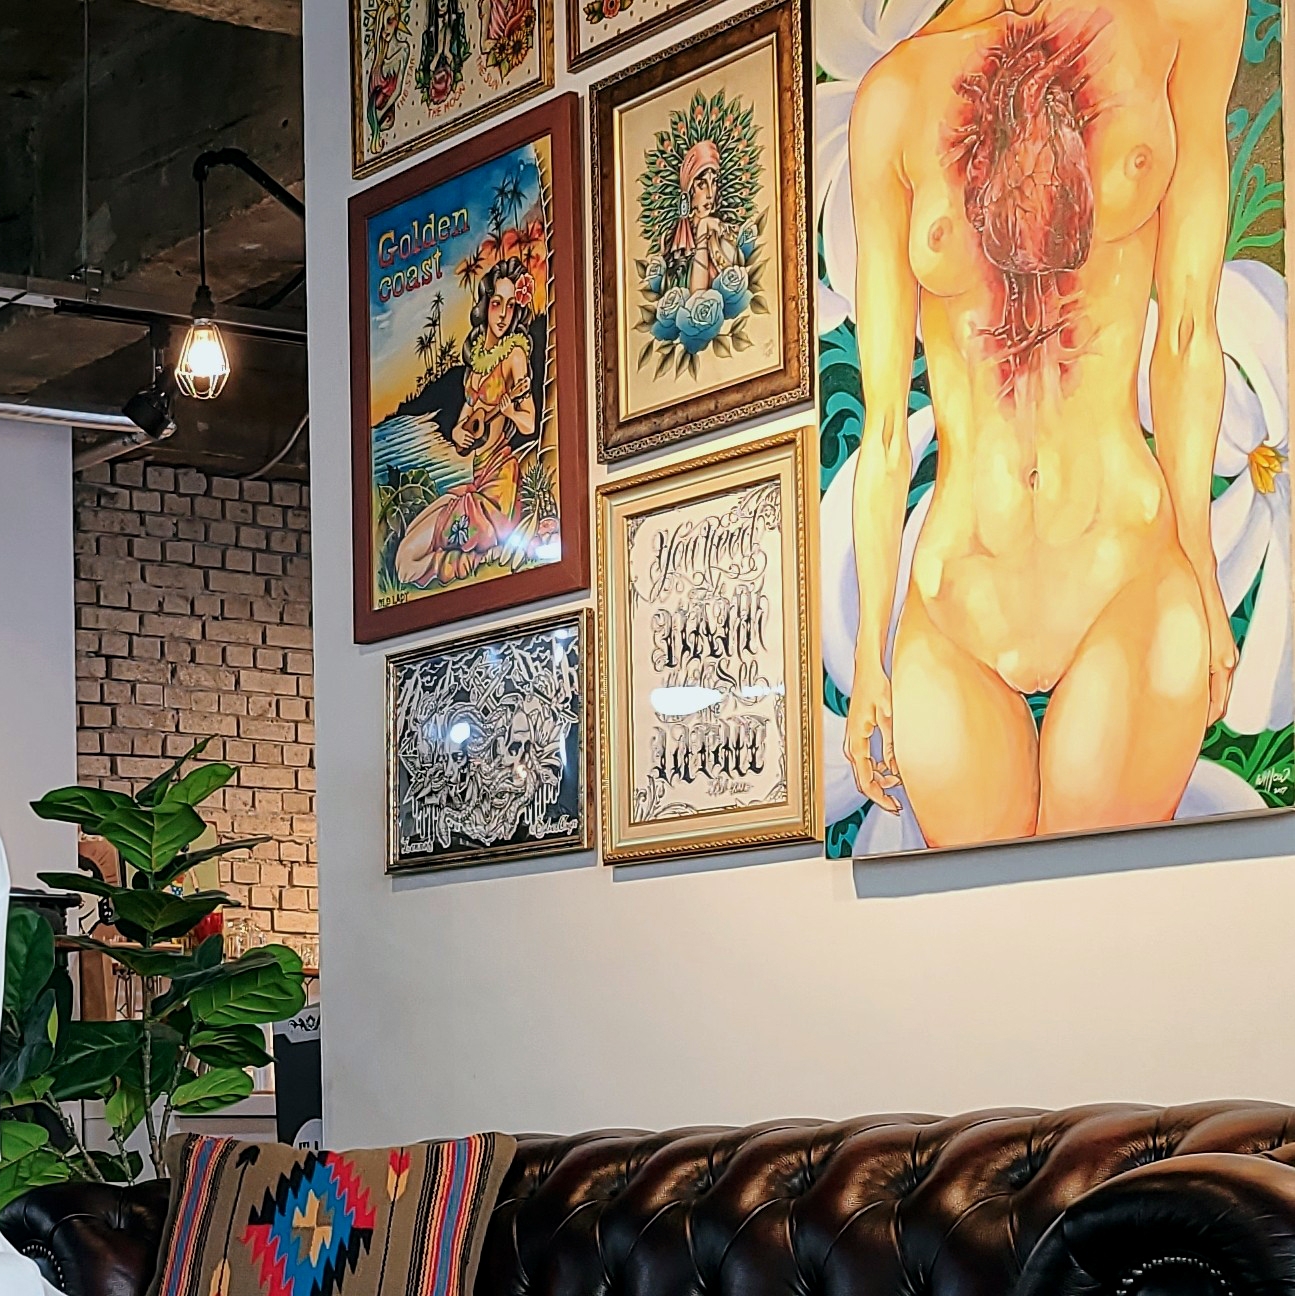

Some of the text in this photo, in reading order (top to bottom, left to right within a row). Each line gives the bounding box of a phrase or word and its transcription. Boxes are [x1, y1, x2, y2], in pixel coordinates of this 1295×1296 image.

[426, 108, 442, 119] THE
[378, 208, 470, 268] Golden
[378, 246, 443, 302] coast
